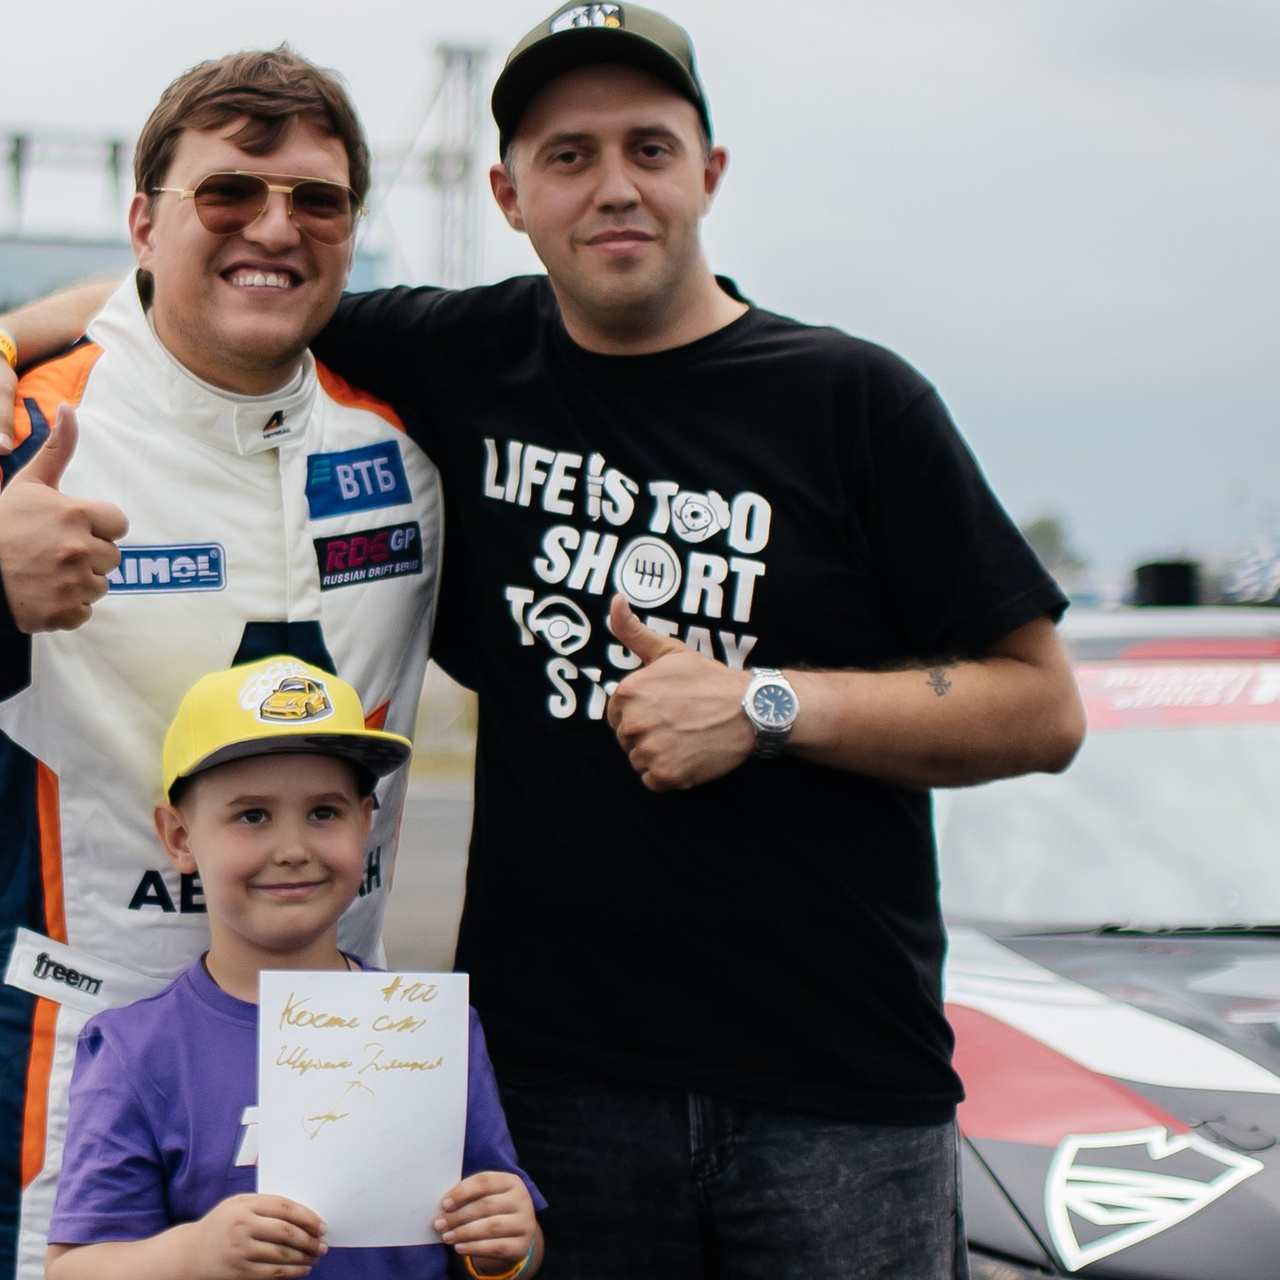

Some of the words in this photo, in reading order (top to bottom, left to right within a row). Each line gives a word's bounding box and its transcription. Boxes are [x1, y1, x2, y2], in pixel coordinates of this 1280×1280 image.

[336, 457, 396, 500] ВТБ
[484, 438, 583, 516] LIFE
[587, 452, 639, 526] IS
[649, 480, 772, 554] TOO
[326, 531, 389, 571] RDS
[391, 527, 416, 551] GP
[323, 570, 366, 586] RUSSIAN
[368, 564, 394, 578] DRIFT
[534, 525, 766, 623] SHORT
[505, 586, 592, 656] TO
[33, 952, 103, 996] freem
